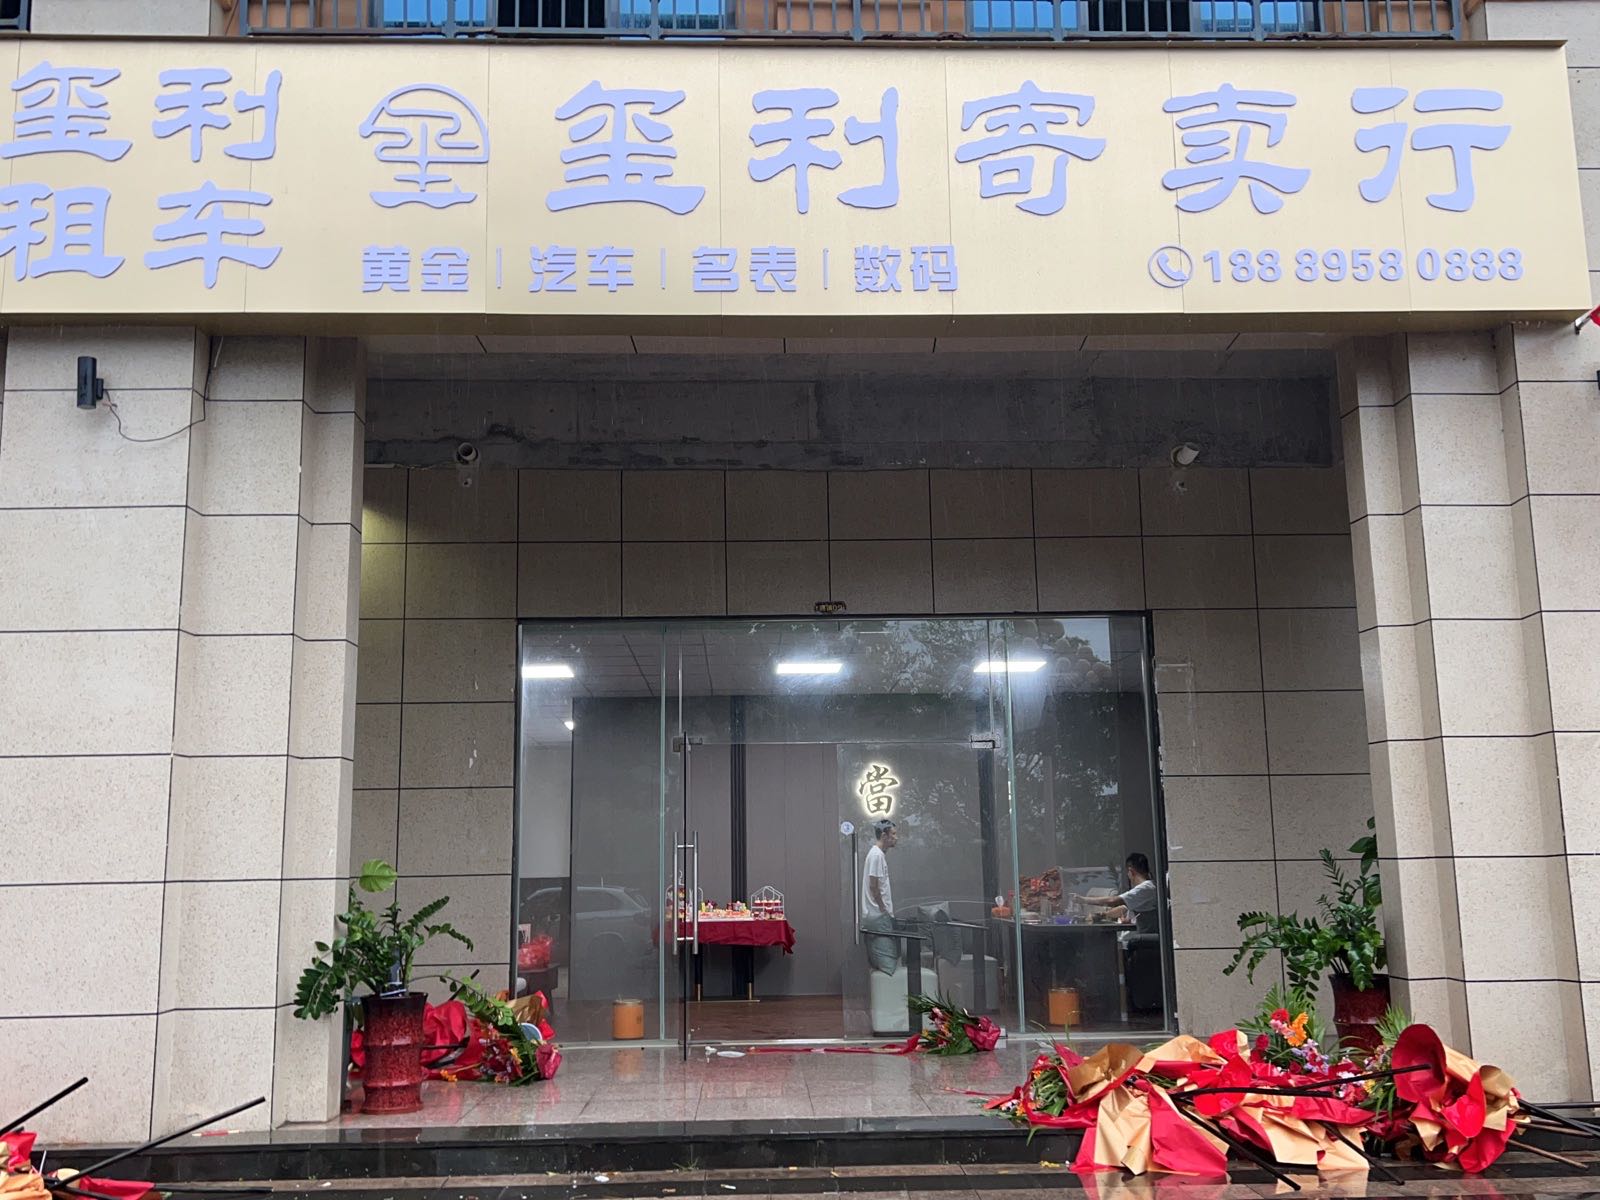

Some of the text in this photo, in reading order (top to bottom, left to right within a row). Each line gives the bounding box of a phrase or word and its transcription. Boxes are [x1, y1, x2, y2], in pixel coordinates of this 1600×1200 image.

[0, 61, 282, 161] 玺利
[546, 80, 1512, 216] 玺利寄卖行
[0, 182, 282, 289] 租车
[362, 244, 959, 293] 黄金 汽车 名表 数码
[1204, 247, 1524, 283] 188 8958 0888
[858, 764, 899, 814] 當
